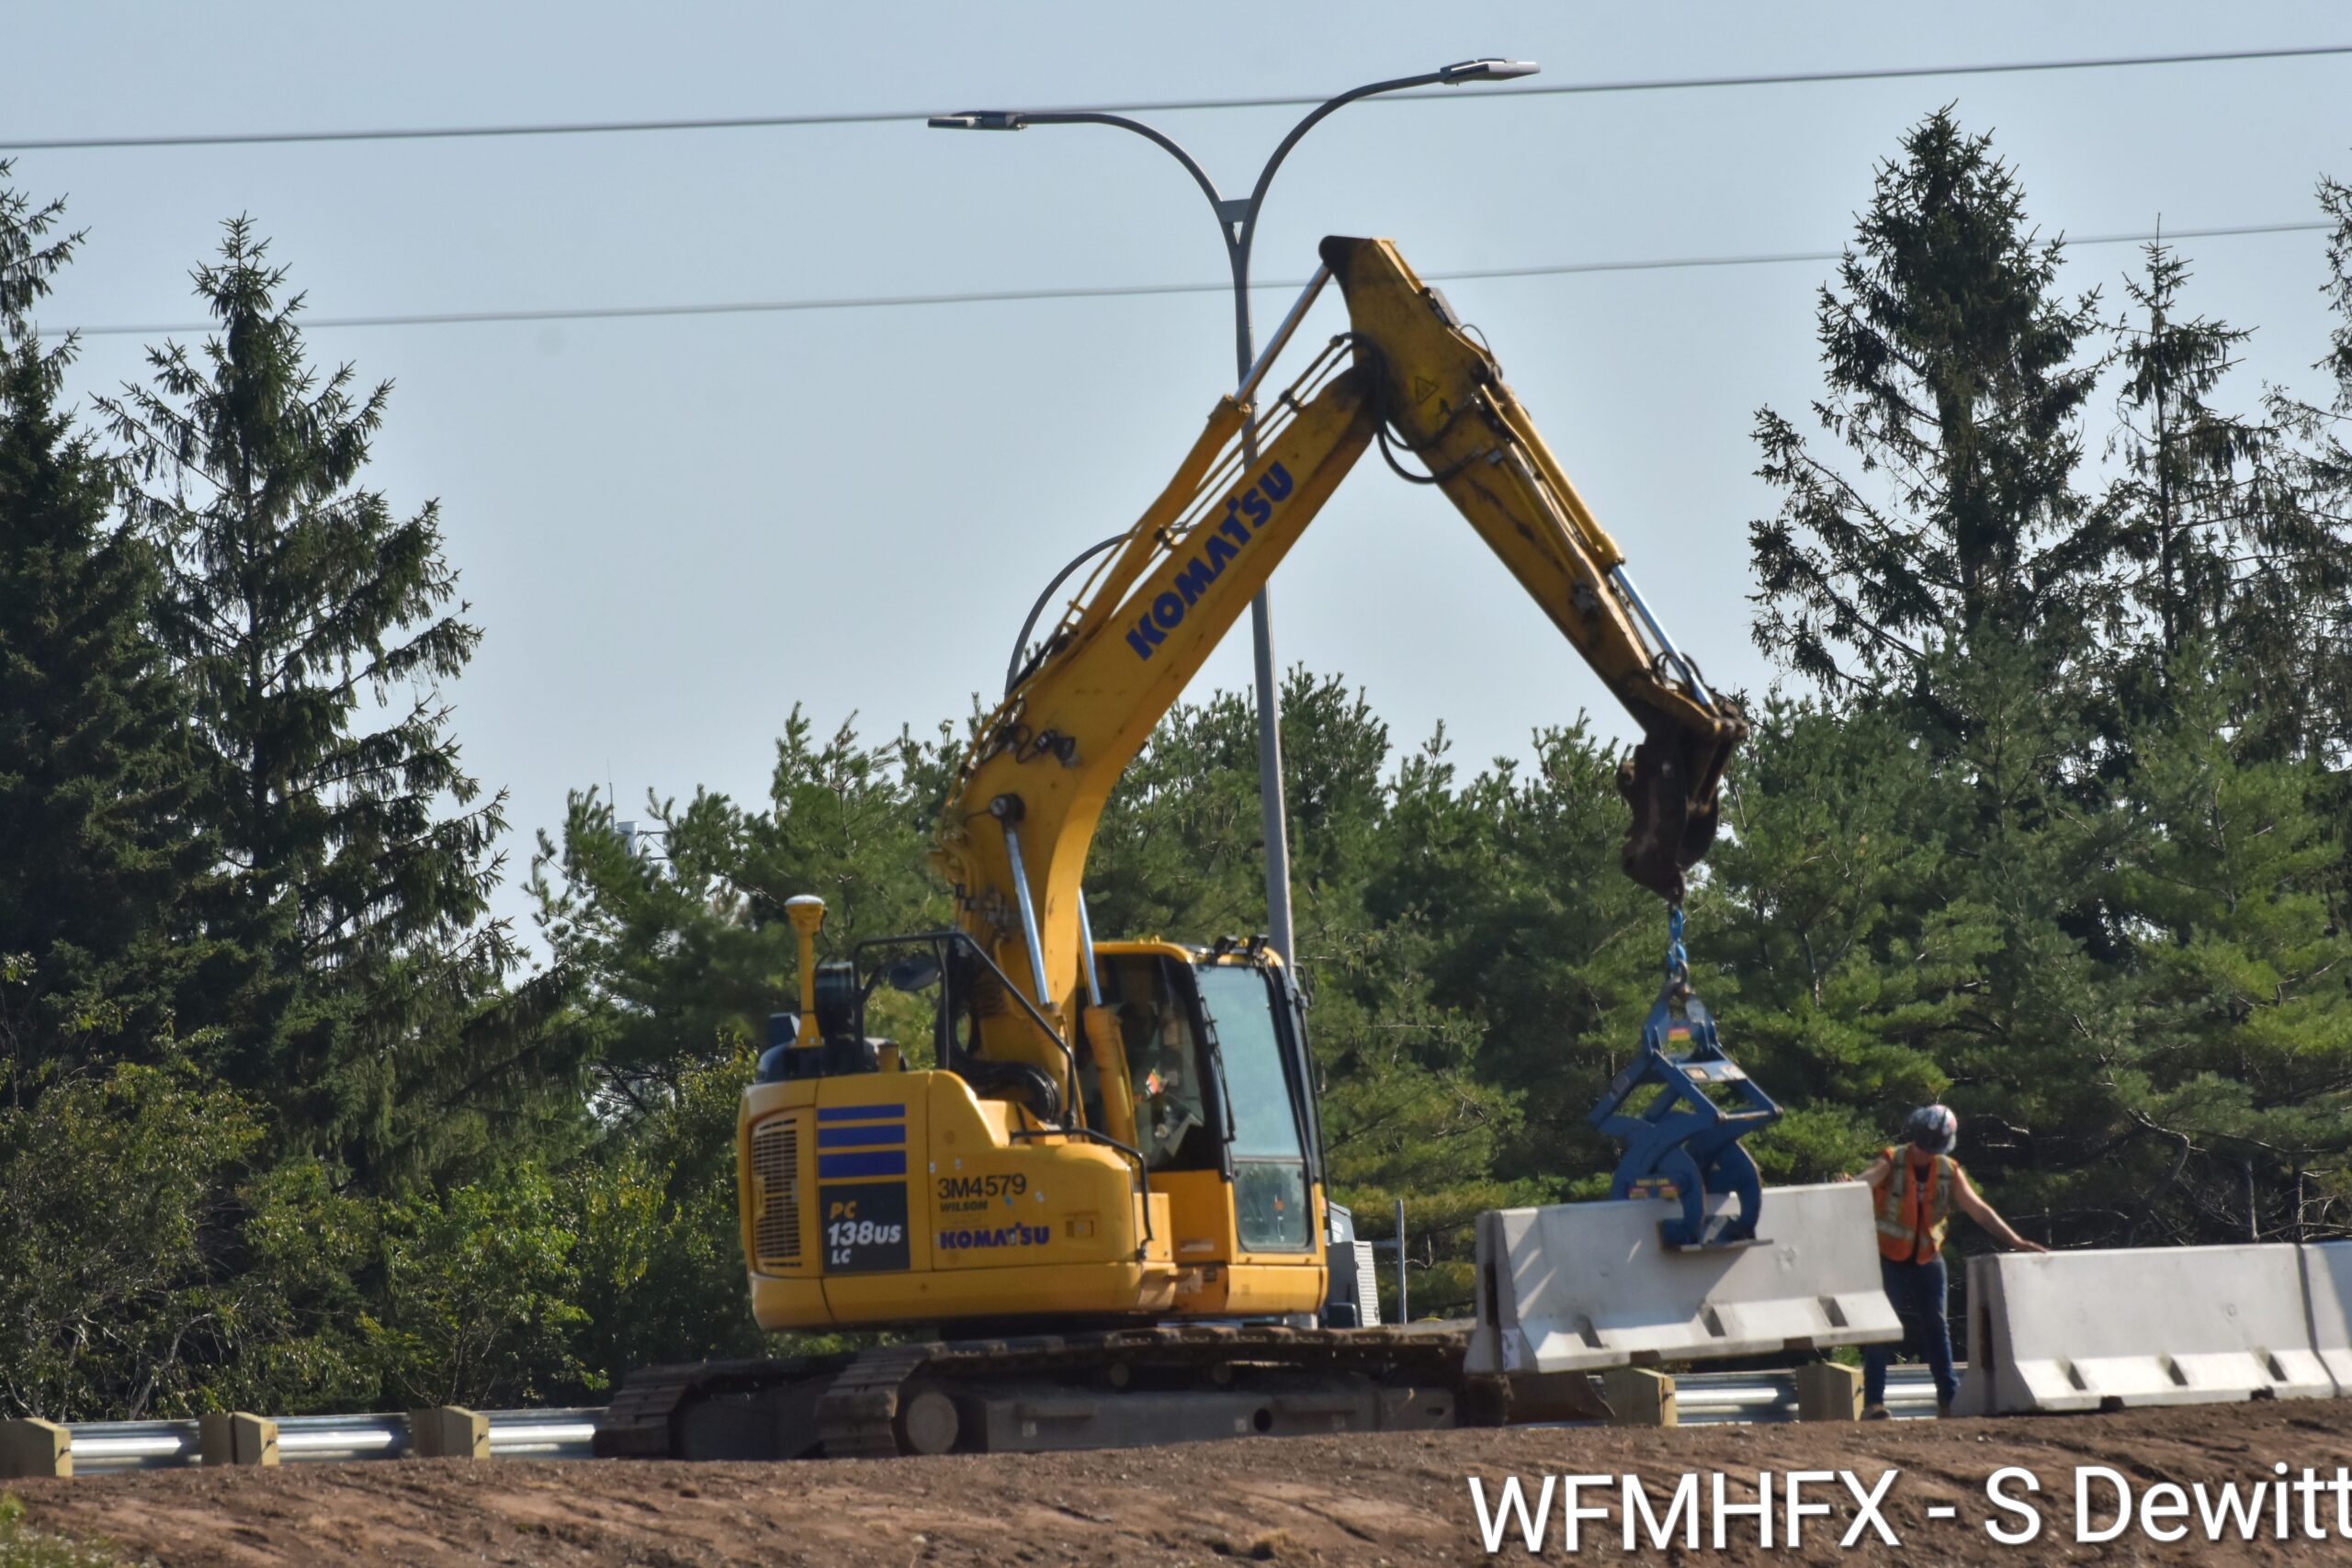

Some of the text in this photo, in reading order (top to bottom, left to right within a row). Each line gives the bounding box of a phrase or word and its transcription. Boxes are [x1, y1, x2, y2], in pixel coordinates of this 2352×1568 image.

[1125, 460, 1294, 661] KOMATSU
[938, 1173, 1027, 1199] 3M4579
[830, 1201, 857, 1220] PC
[940, 1201, 988, 1212] WILSON
[940, 1223, 1049, 1249] KOMATSU
[831, 1248, 852, 1264] LC
